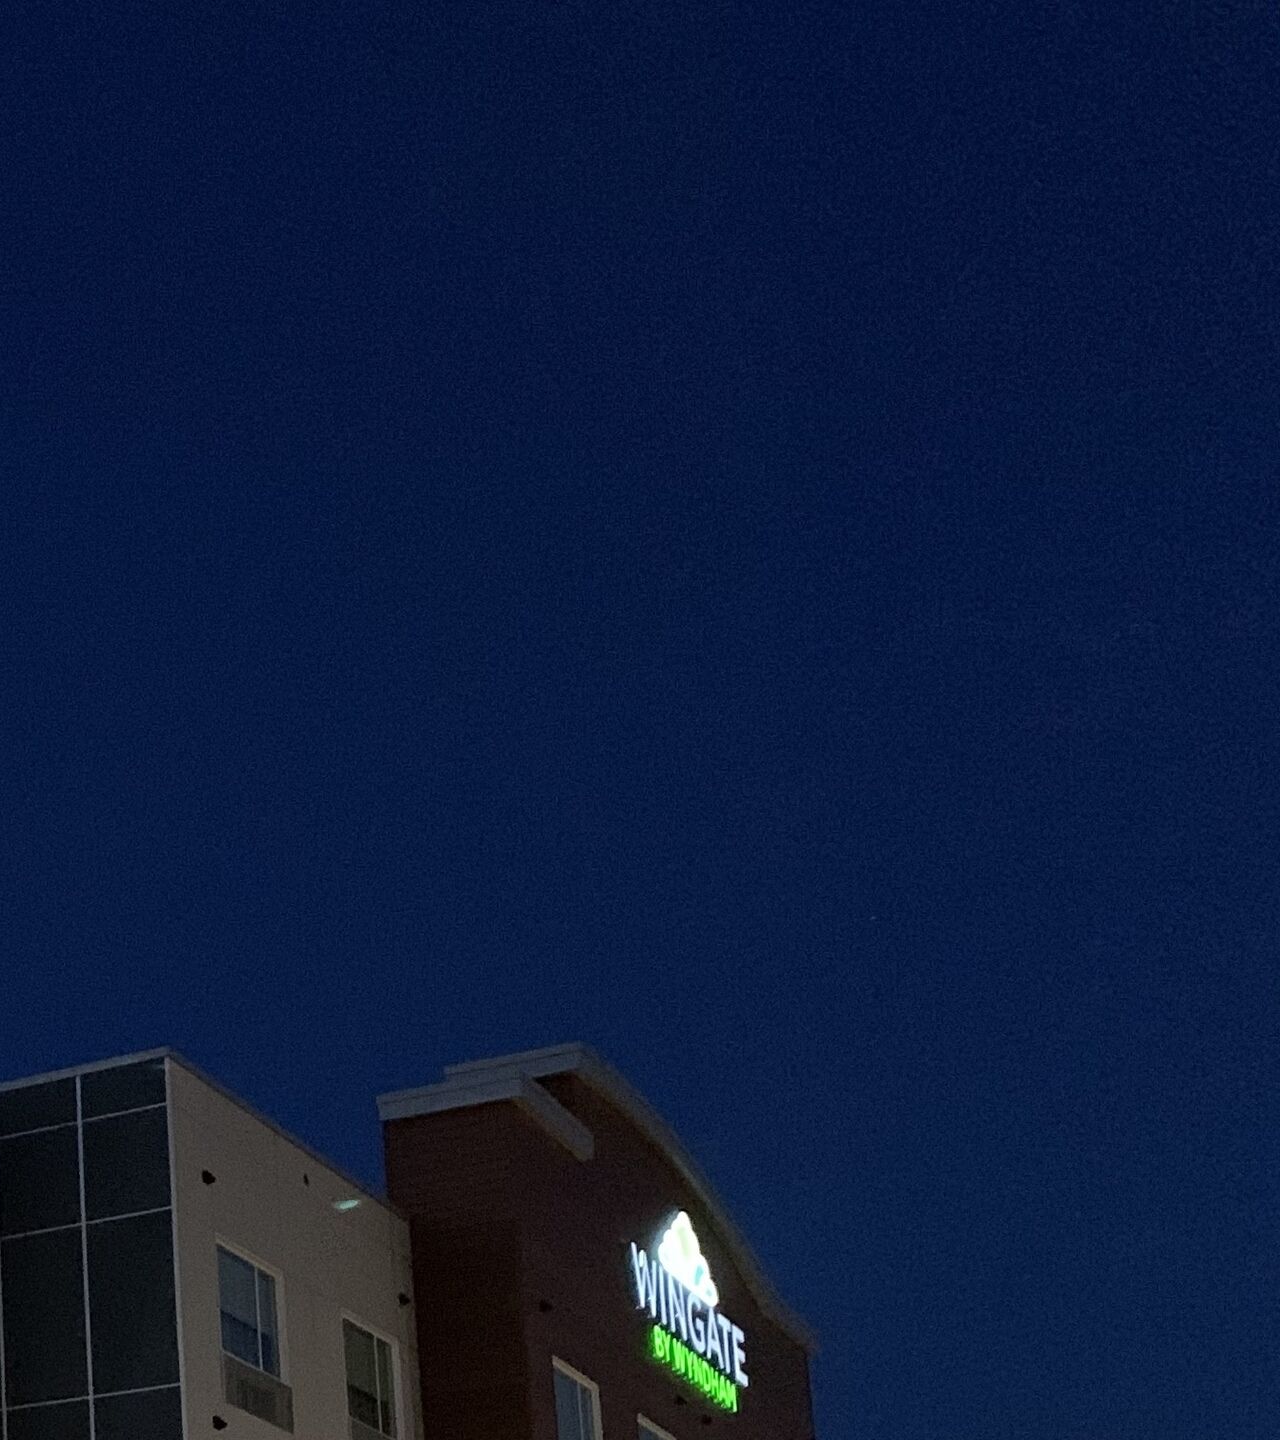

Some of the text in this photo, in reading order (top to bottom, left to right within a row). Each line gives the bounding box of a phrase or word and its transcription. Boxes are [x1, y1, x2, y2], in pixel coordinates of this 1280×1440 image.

[631, 1242, 748, 1387] WINGATE
[653, 1325, 737, 1412] BY WYNDHAM
